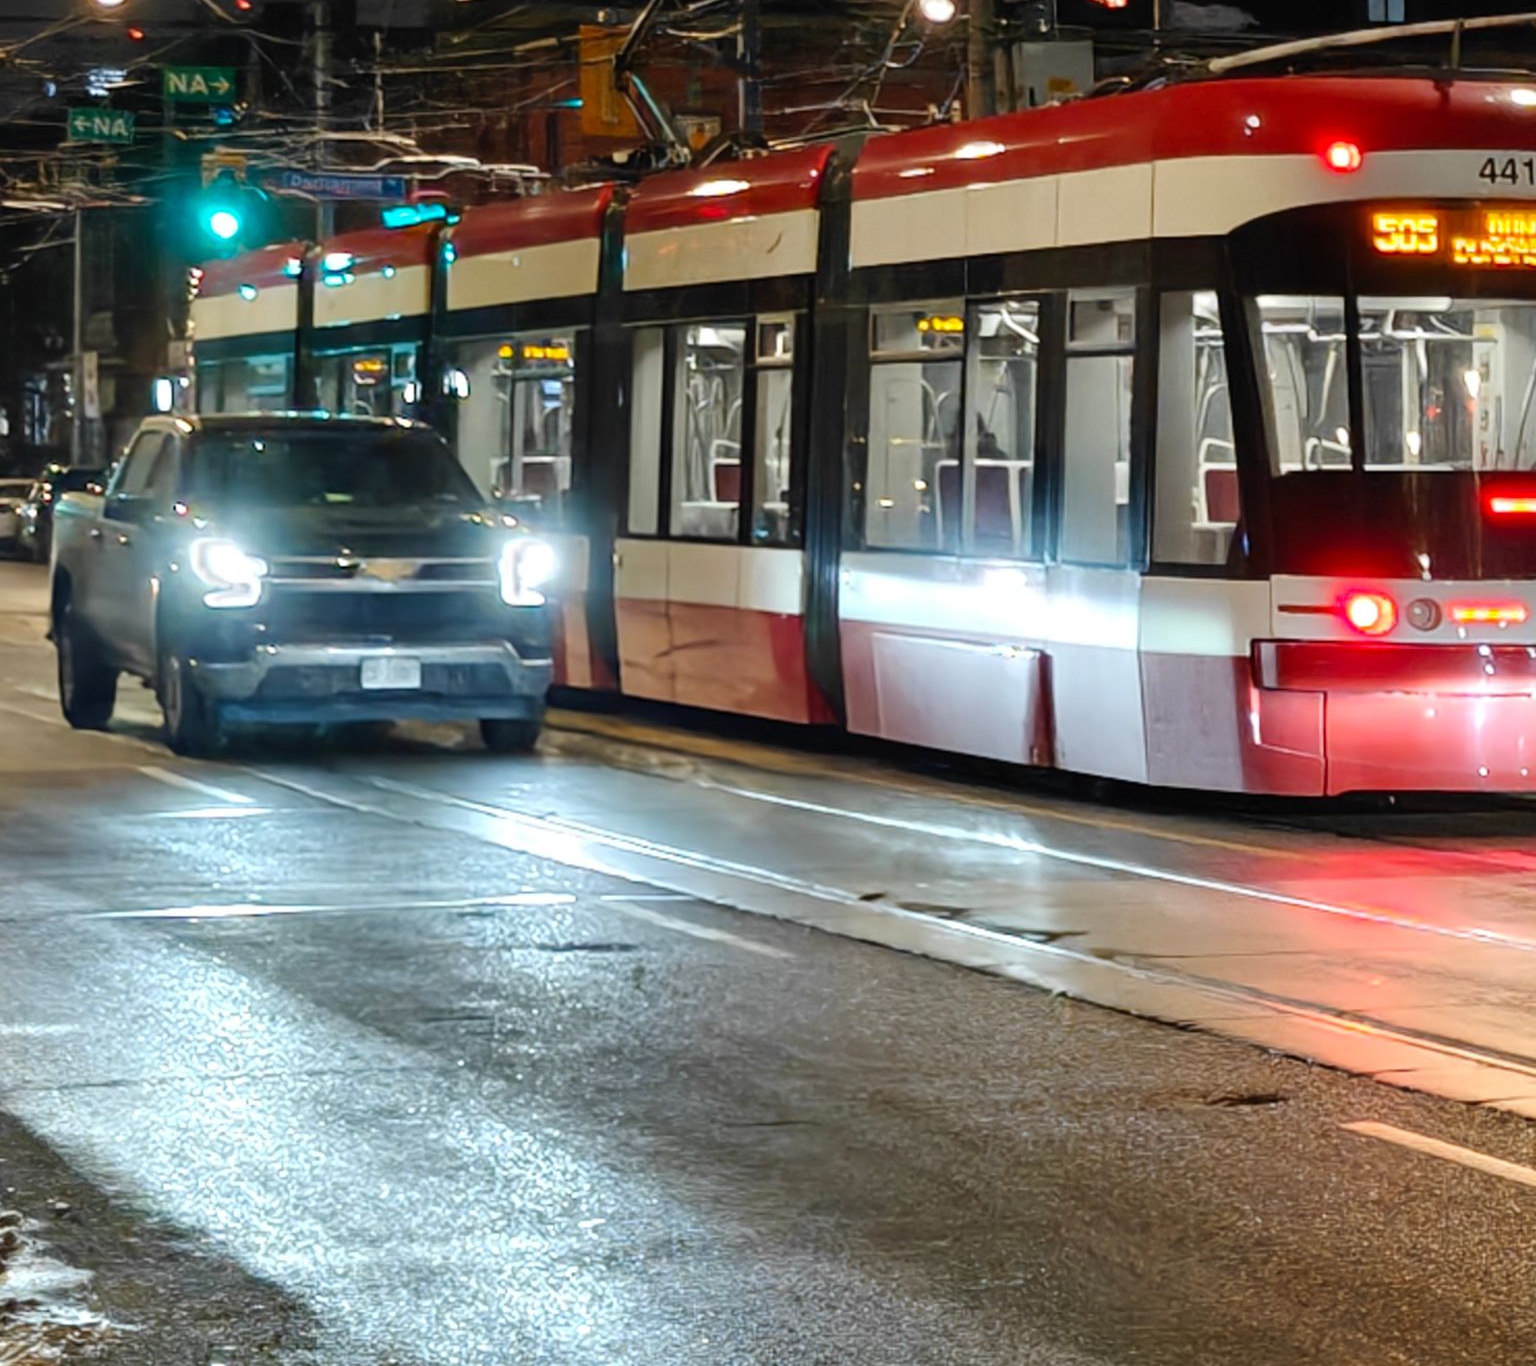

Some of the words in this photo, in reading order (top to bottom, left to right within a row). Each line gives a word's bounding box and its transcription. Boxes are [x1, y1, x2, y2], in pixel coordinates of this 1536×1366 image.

[167, 73, 209, 95] NA
[94, 118, 129, 136] NA
[1374, 215, 1438, 253] 505
